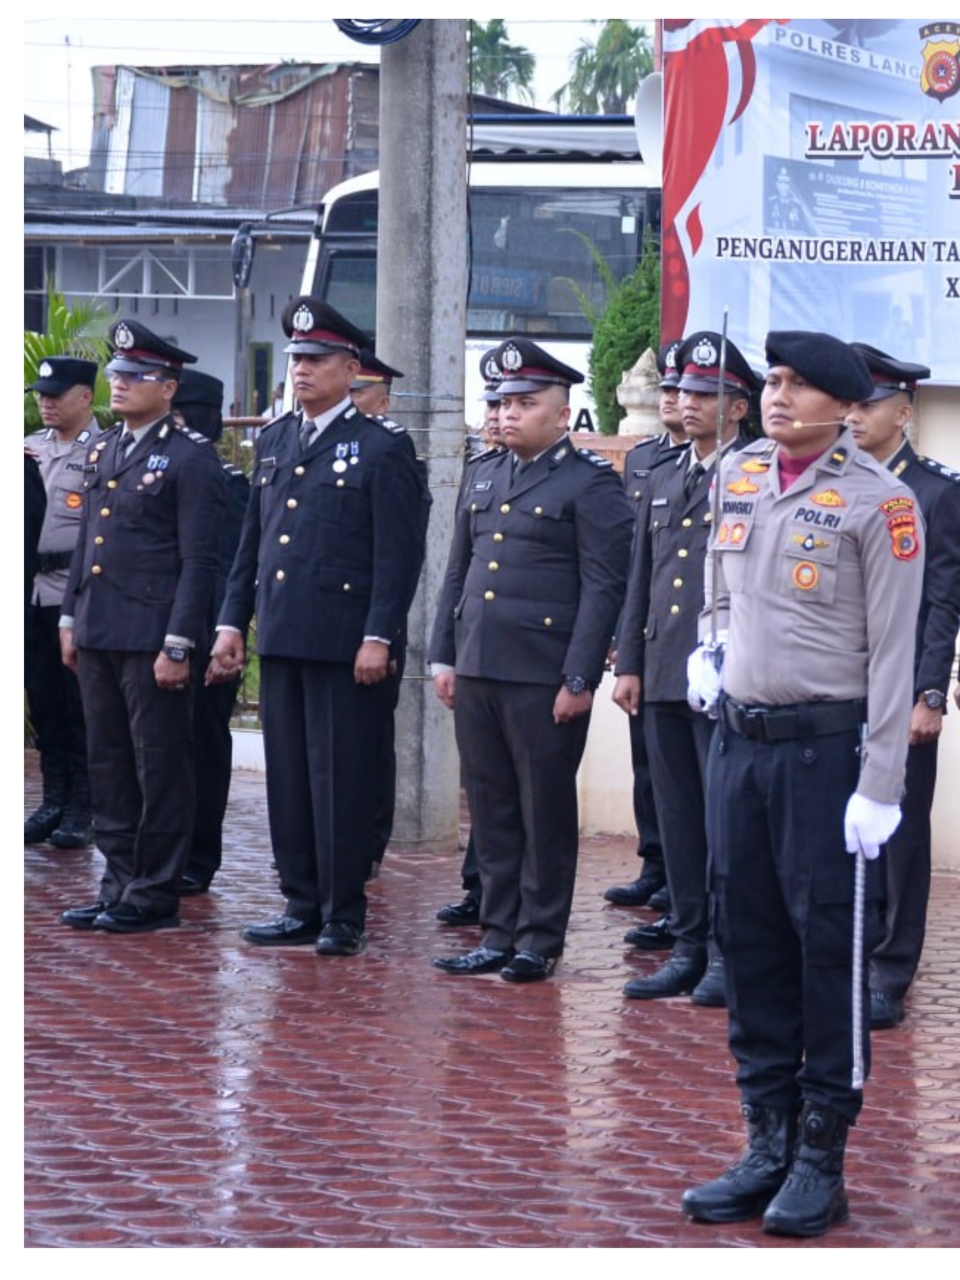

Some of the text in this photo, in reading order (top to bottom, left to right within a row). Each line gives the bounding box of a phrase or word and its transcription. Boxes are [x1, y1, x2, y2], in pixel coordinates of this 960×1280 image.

[774, 26, 861, 64] POLRES
[715, 235, 927, 263] PENGANUGERAHAN
[794, 506, 842, 530] POLRI
